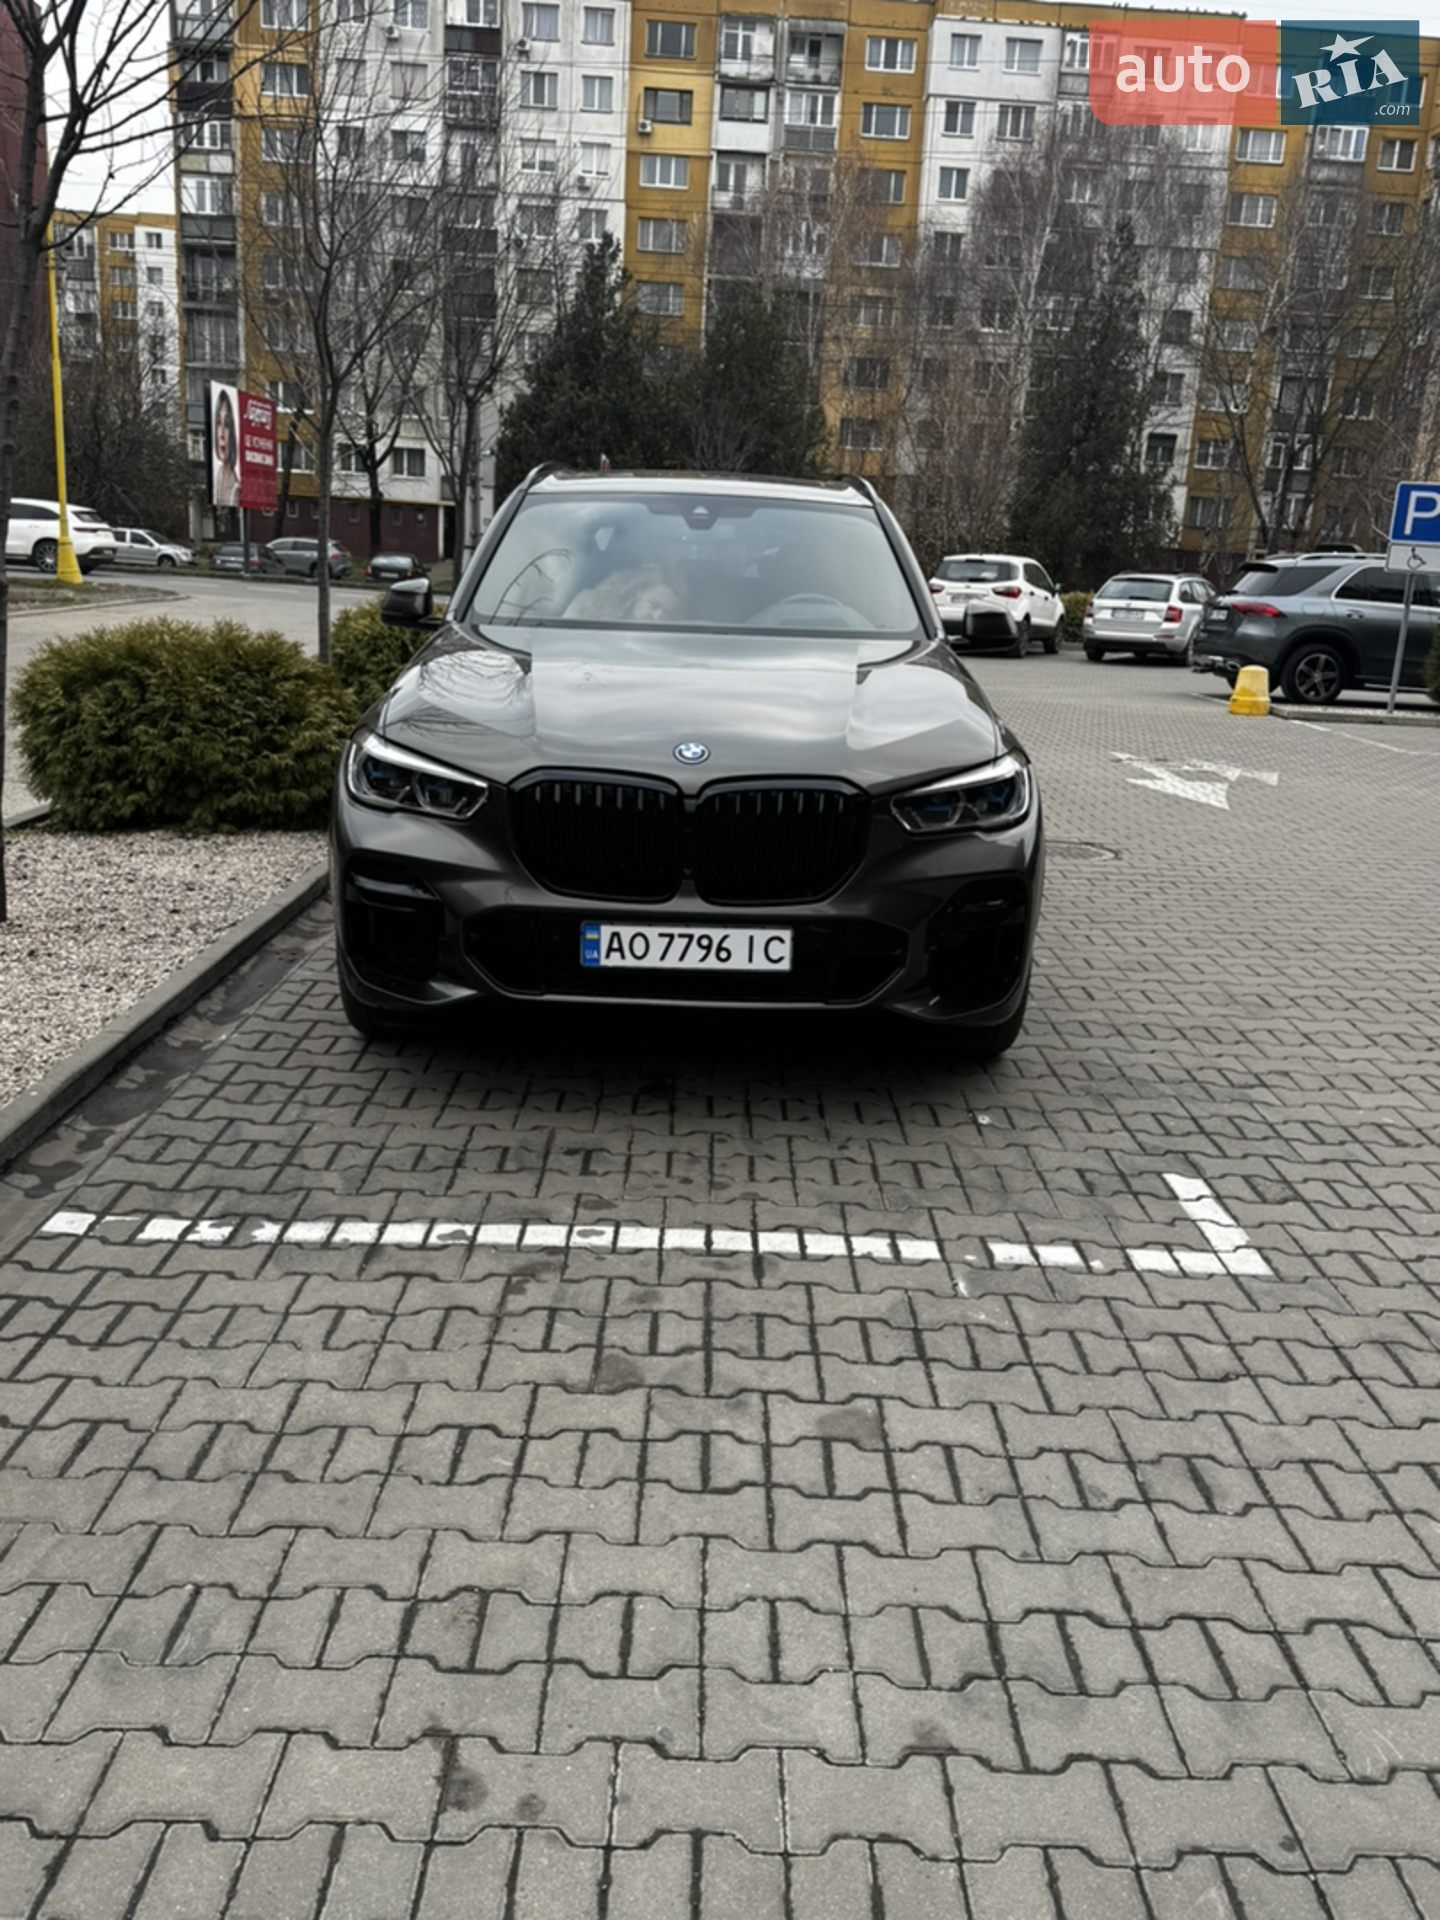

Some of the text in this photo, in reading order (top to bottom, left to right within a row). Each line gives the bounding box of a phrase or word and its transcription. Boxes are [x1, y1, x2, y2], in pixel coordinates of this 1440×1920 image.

[1404, 490, 1440, 536] P
[584, 949, 599, 960] UA
[657, 933, 732, 963] 7796
